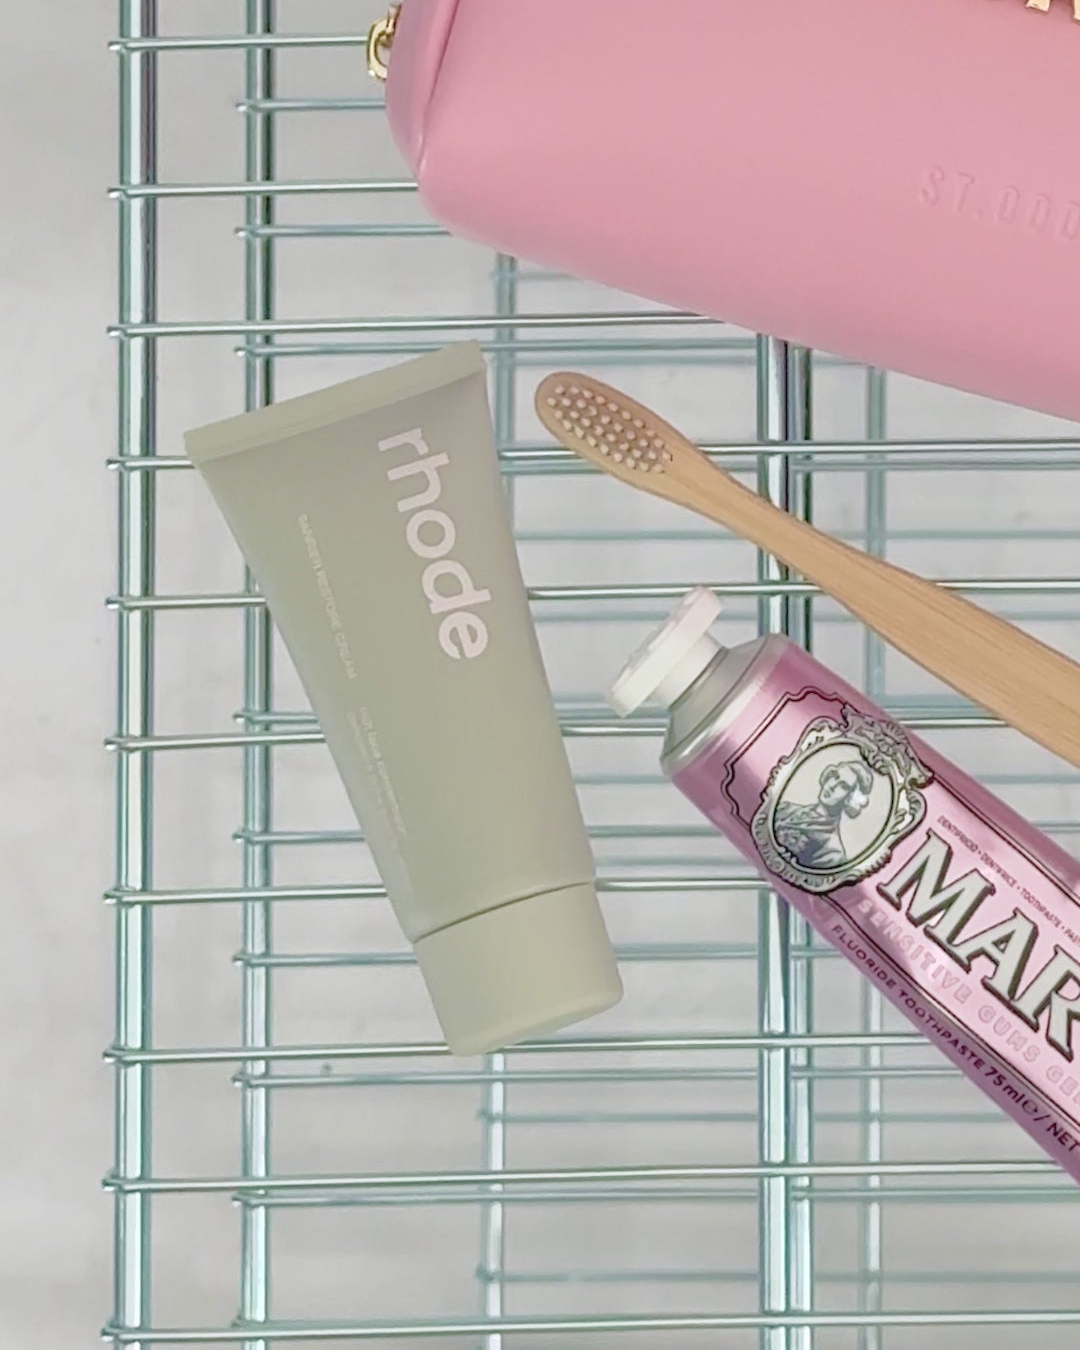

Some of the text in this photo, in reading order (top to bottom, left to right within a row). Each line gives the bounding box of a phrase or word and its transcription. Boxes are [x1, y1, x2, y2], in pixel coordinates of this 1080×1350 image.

[377, 427, 492, 661] rhode
[832, 924, 897, 989] FLUORIDE
[899, 989, 986, 1070] TOOTHPASTE
[857, 900, 973, 1005] SENSITIVE
[978, 1005, 1041, 1063] GUMS
